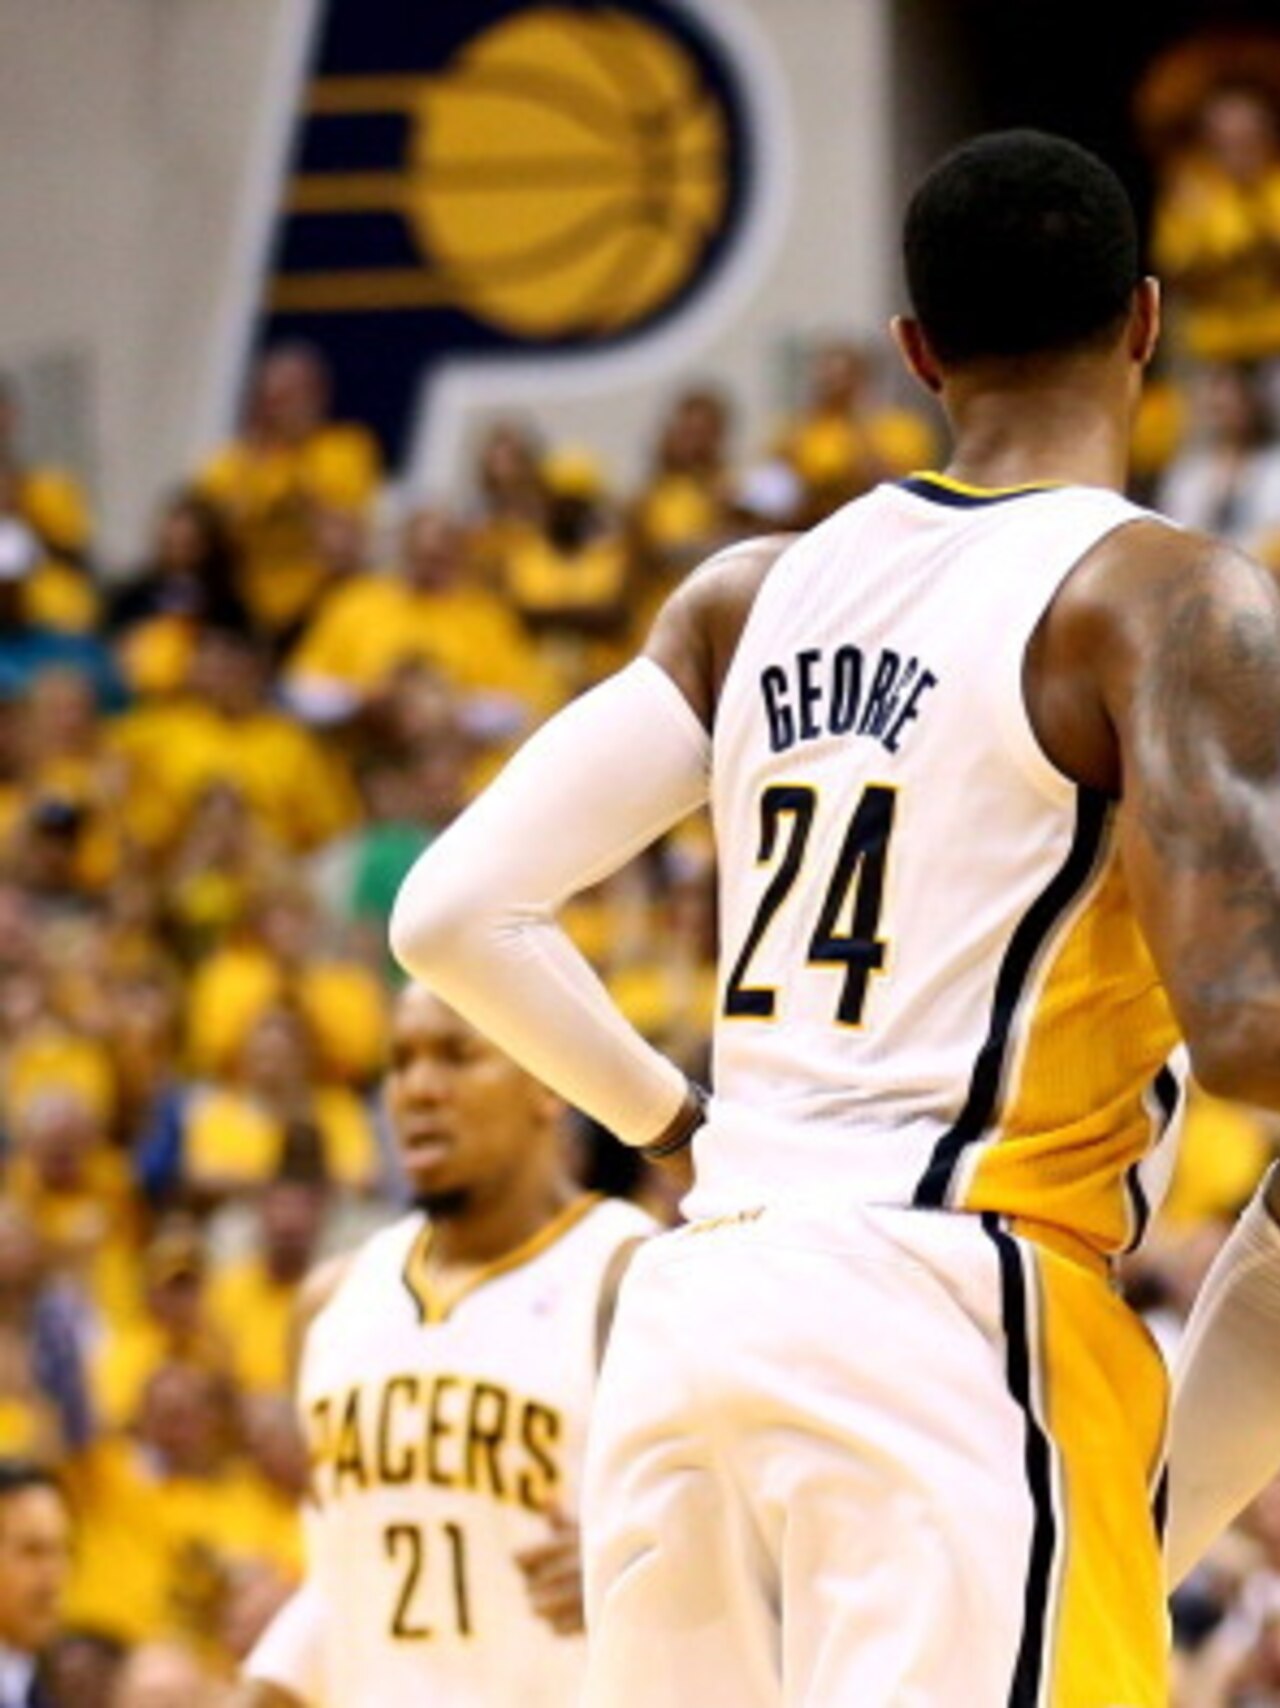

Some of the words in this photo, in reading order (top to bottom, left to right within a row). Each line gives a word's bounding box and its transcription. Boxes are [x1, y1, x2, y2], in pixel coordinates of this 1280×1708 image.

[760, 644, 938, 754] GEORGE
[722, 782, 899, 1029] 24
[383, 1520, 473, 1639] 21
